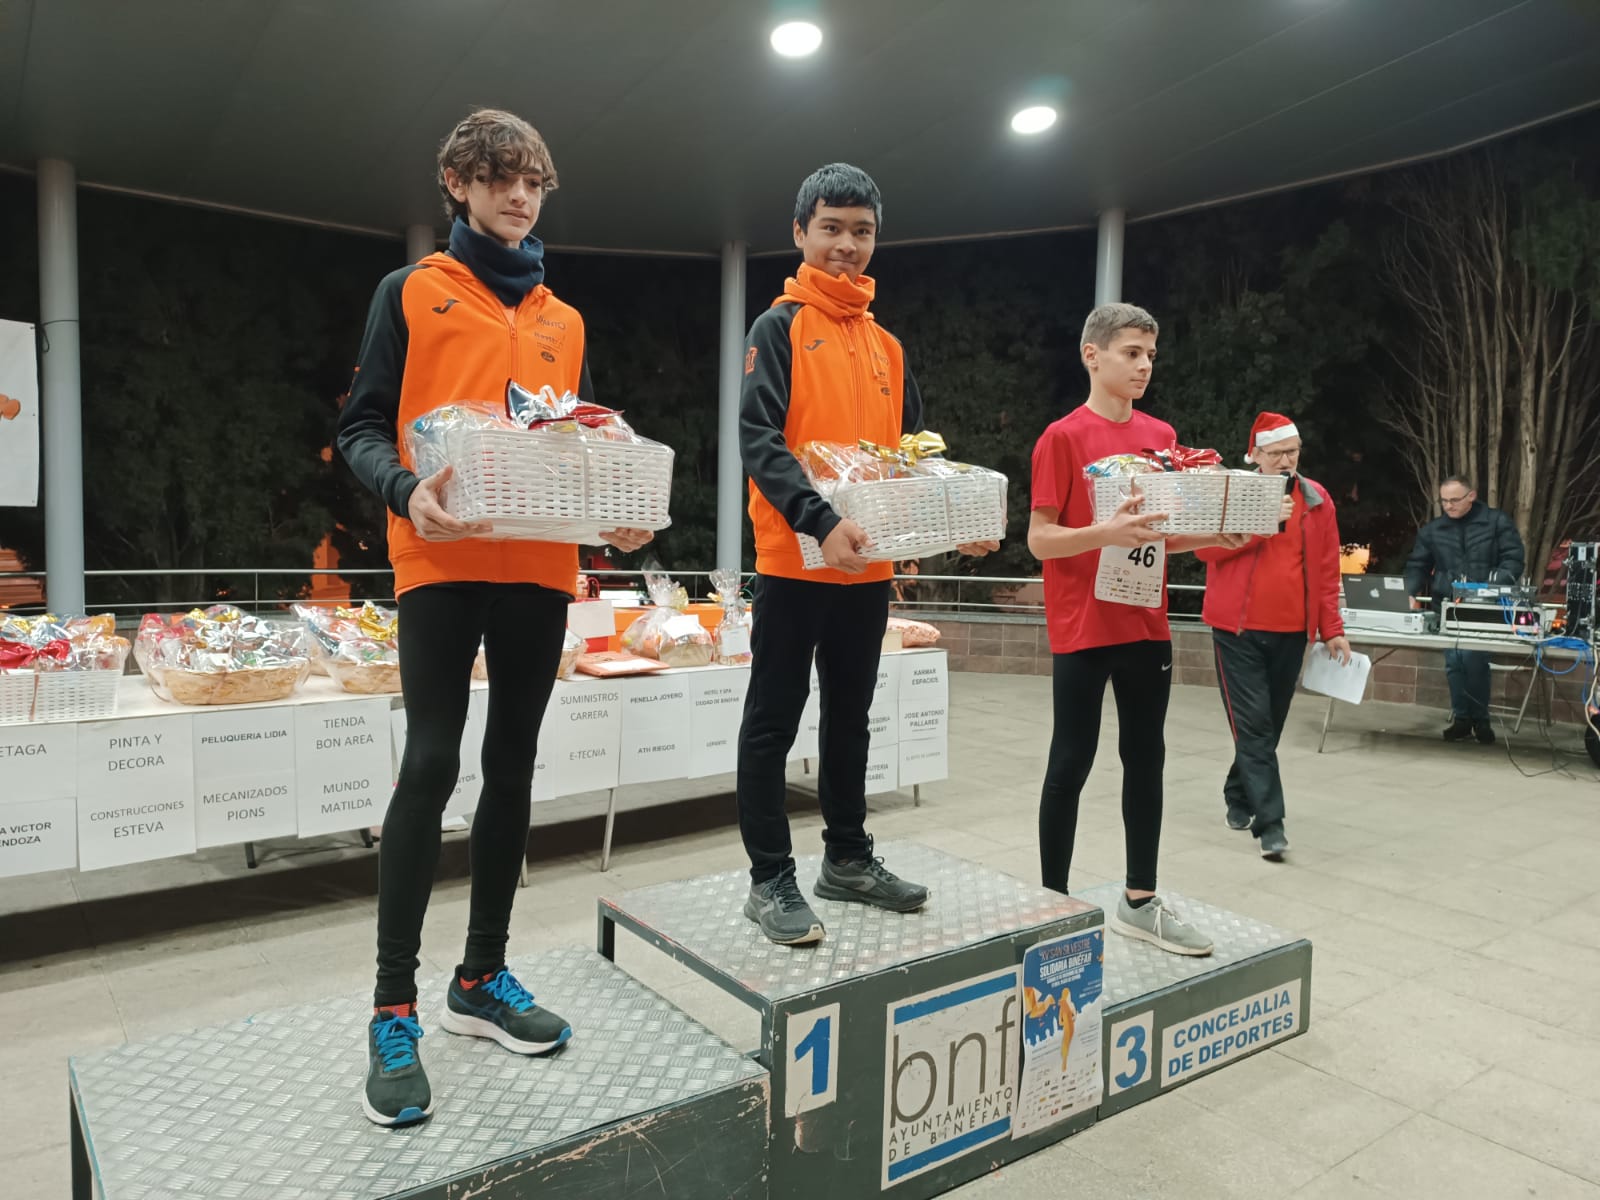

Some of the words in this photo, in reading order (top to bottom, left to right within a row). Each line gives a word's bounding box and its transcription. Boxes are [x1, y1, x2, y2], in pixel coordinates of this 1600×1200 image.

[1128, 545, 1156, 568] 46
[560, 692, 619, 705] SUMINISTROS
[630, 694, 658, 704] PENELLA
[659, 692, 683, 702] JOYERO
[323, 714, 366, 729] TIENDA
[570, 709, 609, 722] CARRERA
[904, 711, 919, 719] JOSE
[920, 709, 945, 718] ANTONIO
[909, 718, 939, 728] PALLARES
[109, 735, 152, 750] PINTA
[153, 733, 163, 746] Y
[201, 731, 263, 745] PELUQUERIA
[265, 729, 288, 741] LIDIA
[315, 738, 341, 751] BON
[343, 734, 375, 748] AREA
[569, 748, 606, 761] E-TECNIA
[637, 746, 652, 755] ATH
[652, 743, 676, 753] RIEGOS
[108, 754, 165, 772] DECORA
[202, 785, 288, 805] MECANIZADOS
[322, 778, 370, 795] MUNDO
[90, 800, 185, 822] CONSTRUCCIONES
[227, 806, 266, 822] PIONS
[320, 796, 373, 815] MATILDA
[10, 821, 52, 834] VICTOR
[113, 820, 164, 838] ESTEVA
[0, 835, 41, 847] NDOZA
[1040, 958, 1068, 978] SOLIDARIA
[1174, 990, 1291, 1048] CONCEJALIA
[1169, 1052, 1193, 1077] DE
[1199, 1012, 1293, 1064] DEPORTES
[795, 1016, 831, 1095] 1
[1115, 1025, 1147, 1088] 3
[889, 1087, 1012, 1146] AYUNTAMIENTO
[889, 1148, 911, 1162] DE
